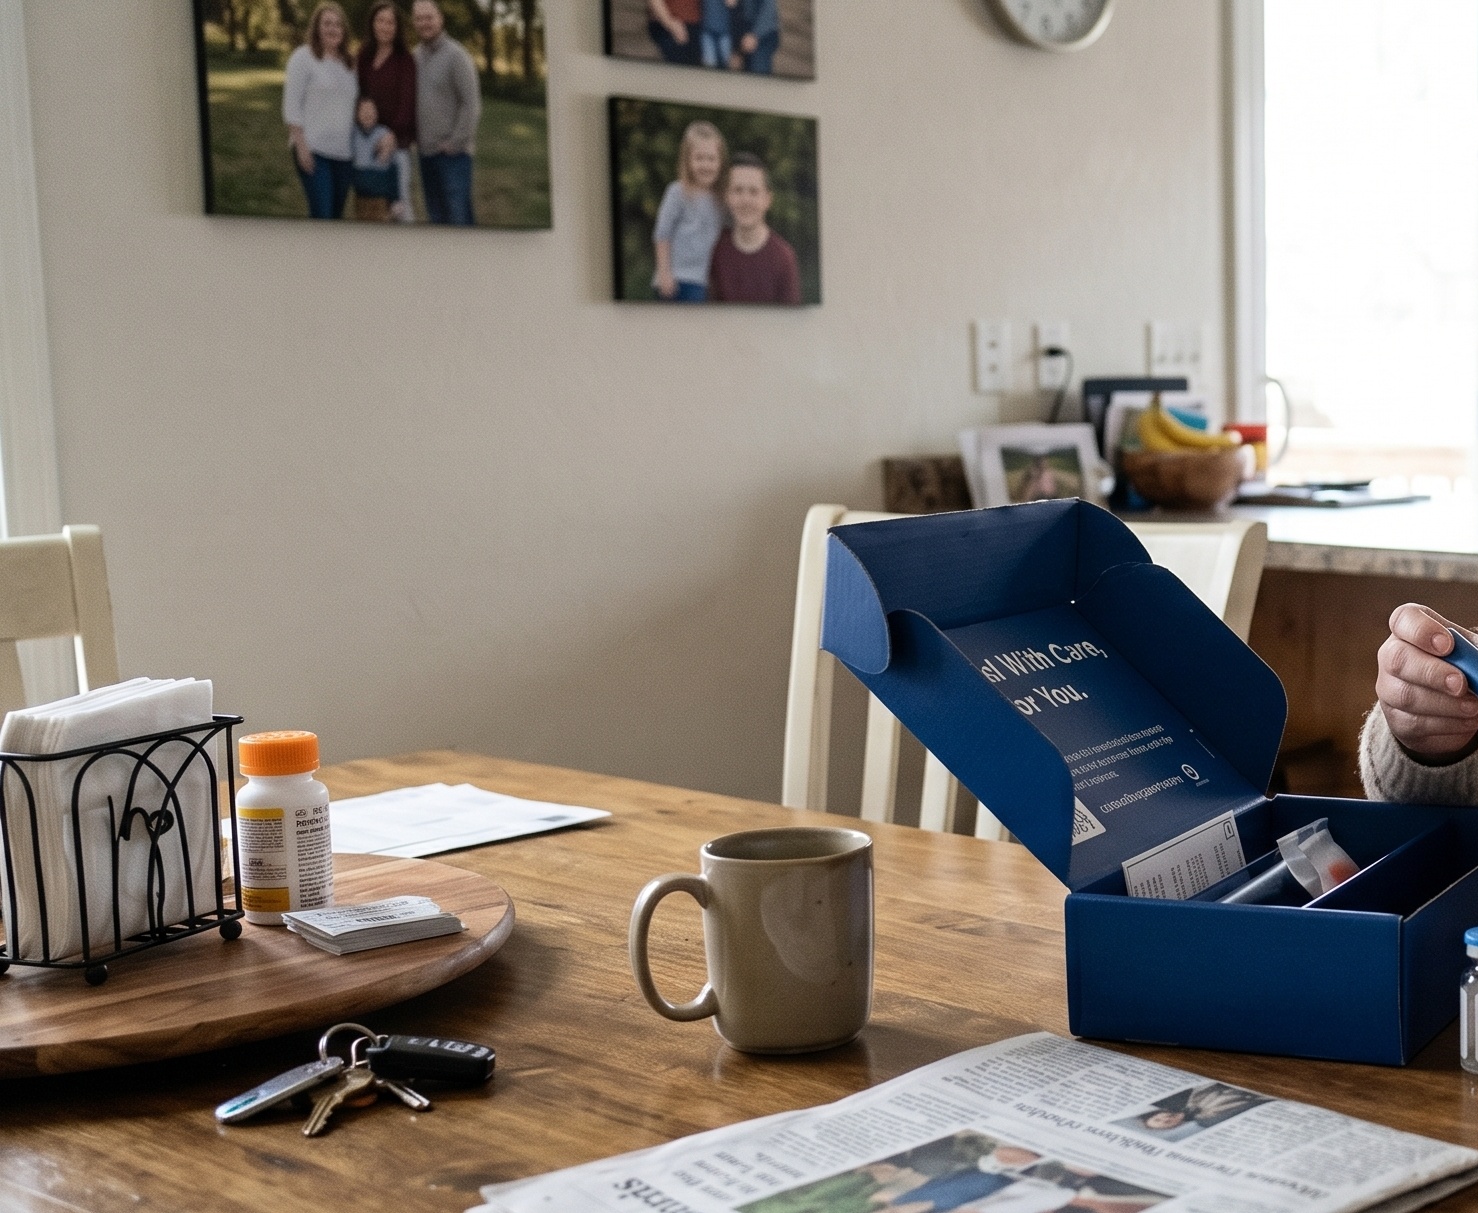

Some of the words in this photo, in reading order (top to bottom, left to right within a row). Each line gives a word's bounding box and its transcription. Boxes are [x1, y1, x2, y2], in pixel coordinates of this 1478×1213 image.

[993, 647, 1056, 677] With
[1048, 641, 1108, 664] Care,
[1032, 684, 1089, 708] You.
